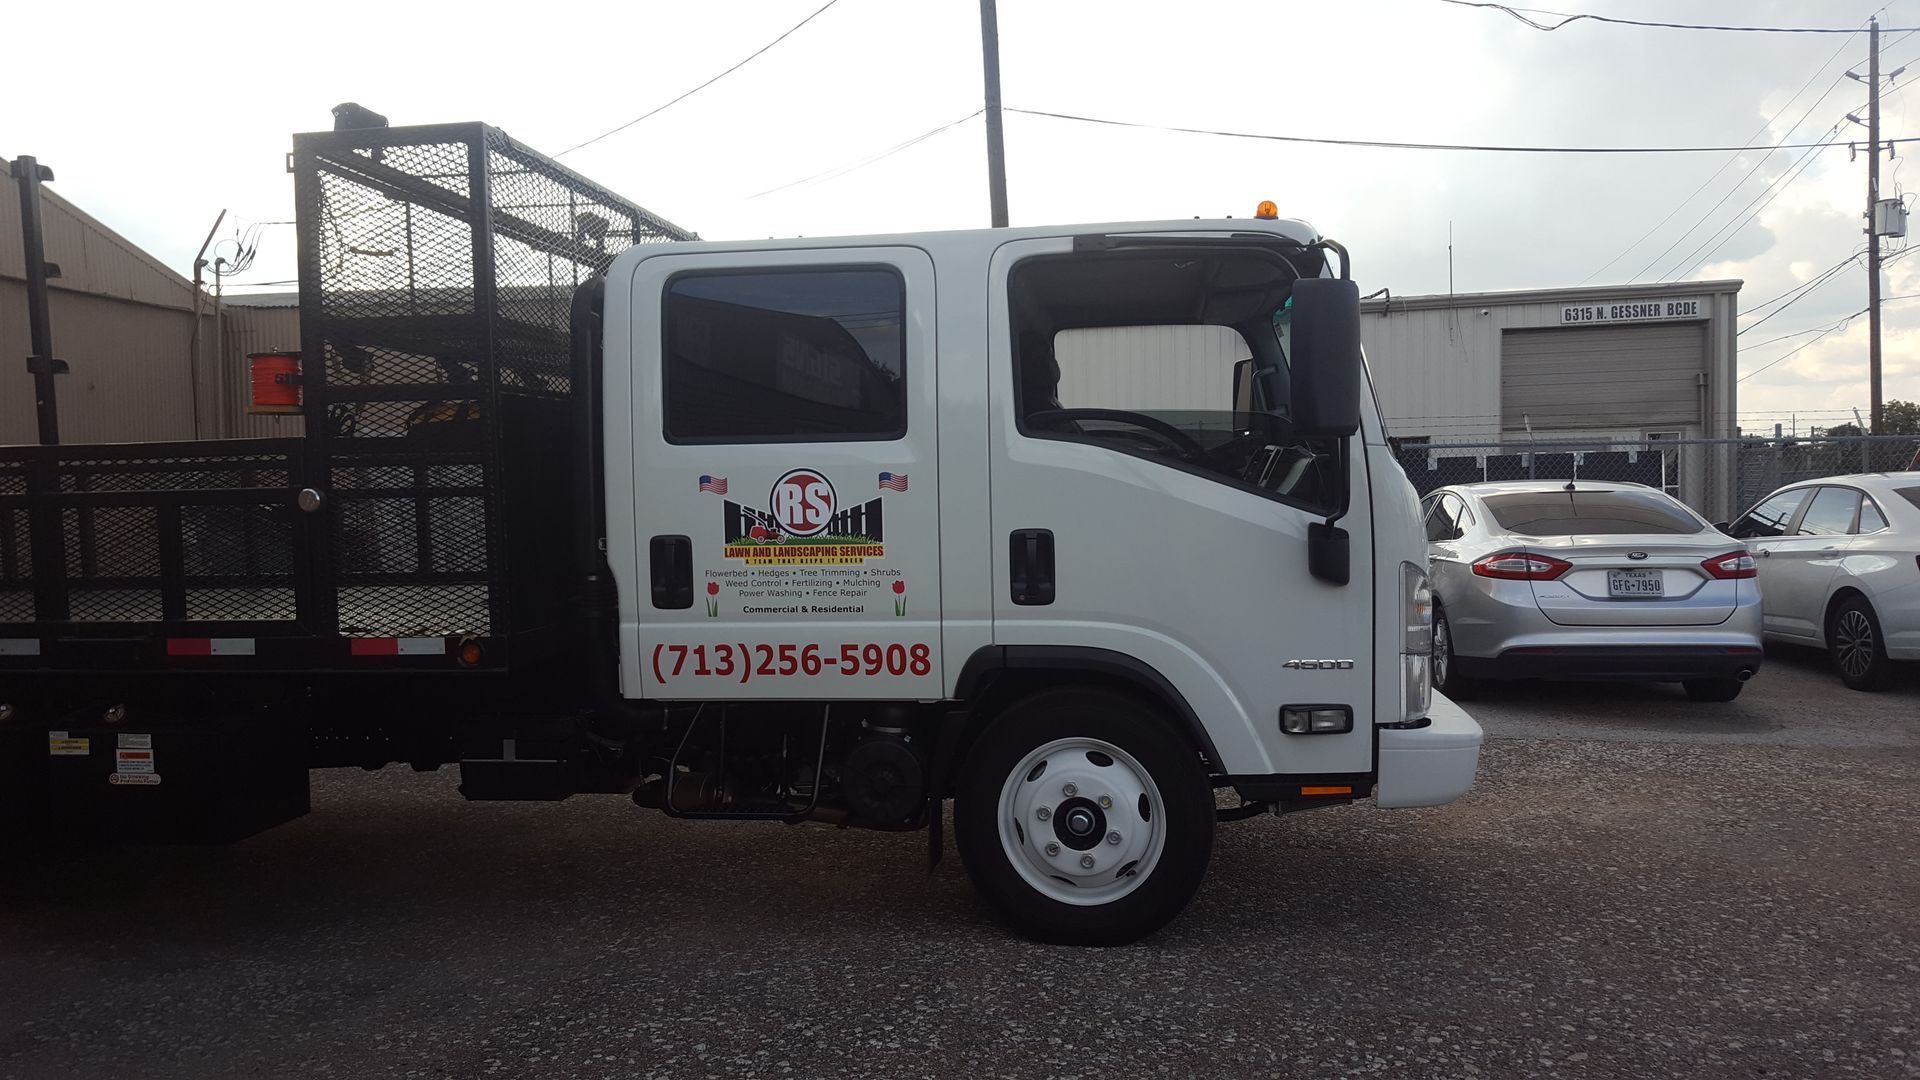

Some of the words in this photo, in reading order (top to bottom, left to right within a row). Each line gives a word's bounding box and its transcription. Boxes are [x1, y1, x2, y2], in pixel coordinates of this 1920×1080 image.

[1564, 308, 1592, 321] 6315
[1596, 307, 1607, 320] N.
[1611, 304, 1661, 319] GESSNER
[1667, 301, 1697, 316] BCDE
[779, 482, 829, 525] RS
[724, 548, 750, 558] LAWN
[753, 548, 771, 557] AND
[773, 547, 837, 557] LANDSCAPING
[839, 545, 884, 557] SERVICES
[705, 569, 748, 578] Flowerbed
[758, 569, 789, 579] Hedges
[800, 569, 818, 577] Tree
[821, 569, 860, 578] Trimming
[870, 568, 901, 577] Shrubs
[725, 579, 748, 587] Weed
[751, 579, 782, 587] Control
[792, 579, 833, 588] Fertilizing
[843, 578, 881, 588] Mulching
[739, 589, 764, 597] Power
[767, 588, 803, 599] Washing
[813, 589, 838, 597] Fence
[840, 588, 868, 598] Repair
[743, 605, 798, 614] Commercial
[801, 605, 809, 613] &
[811, 605, 864, 613] Residential
[652, 643, 931, 684] (713)256-5908
[1281, 659, 1354, 670] 4500
